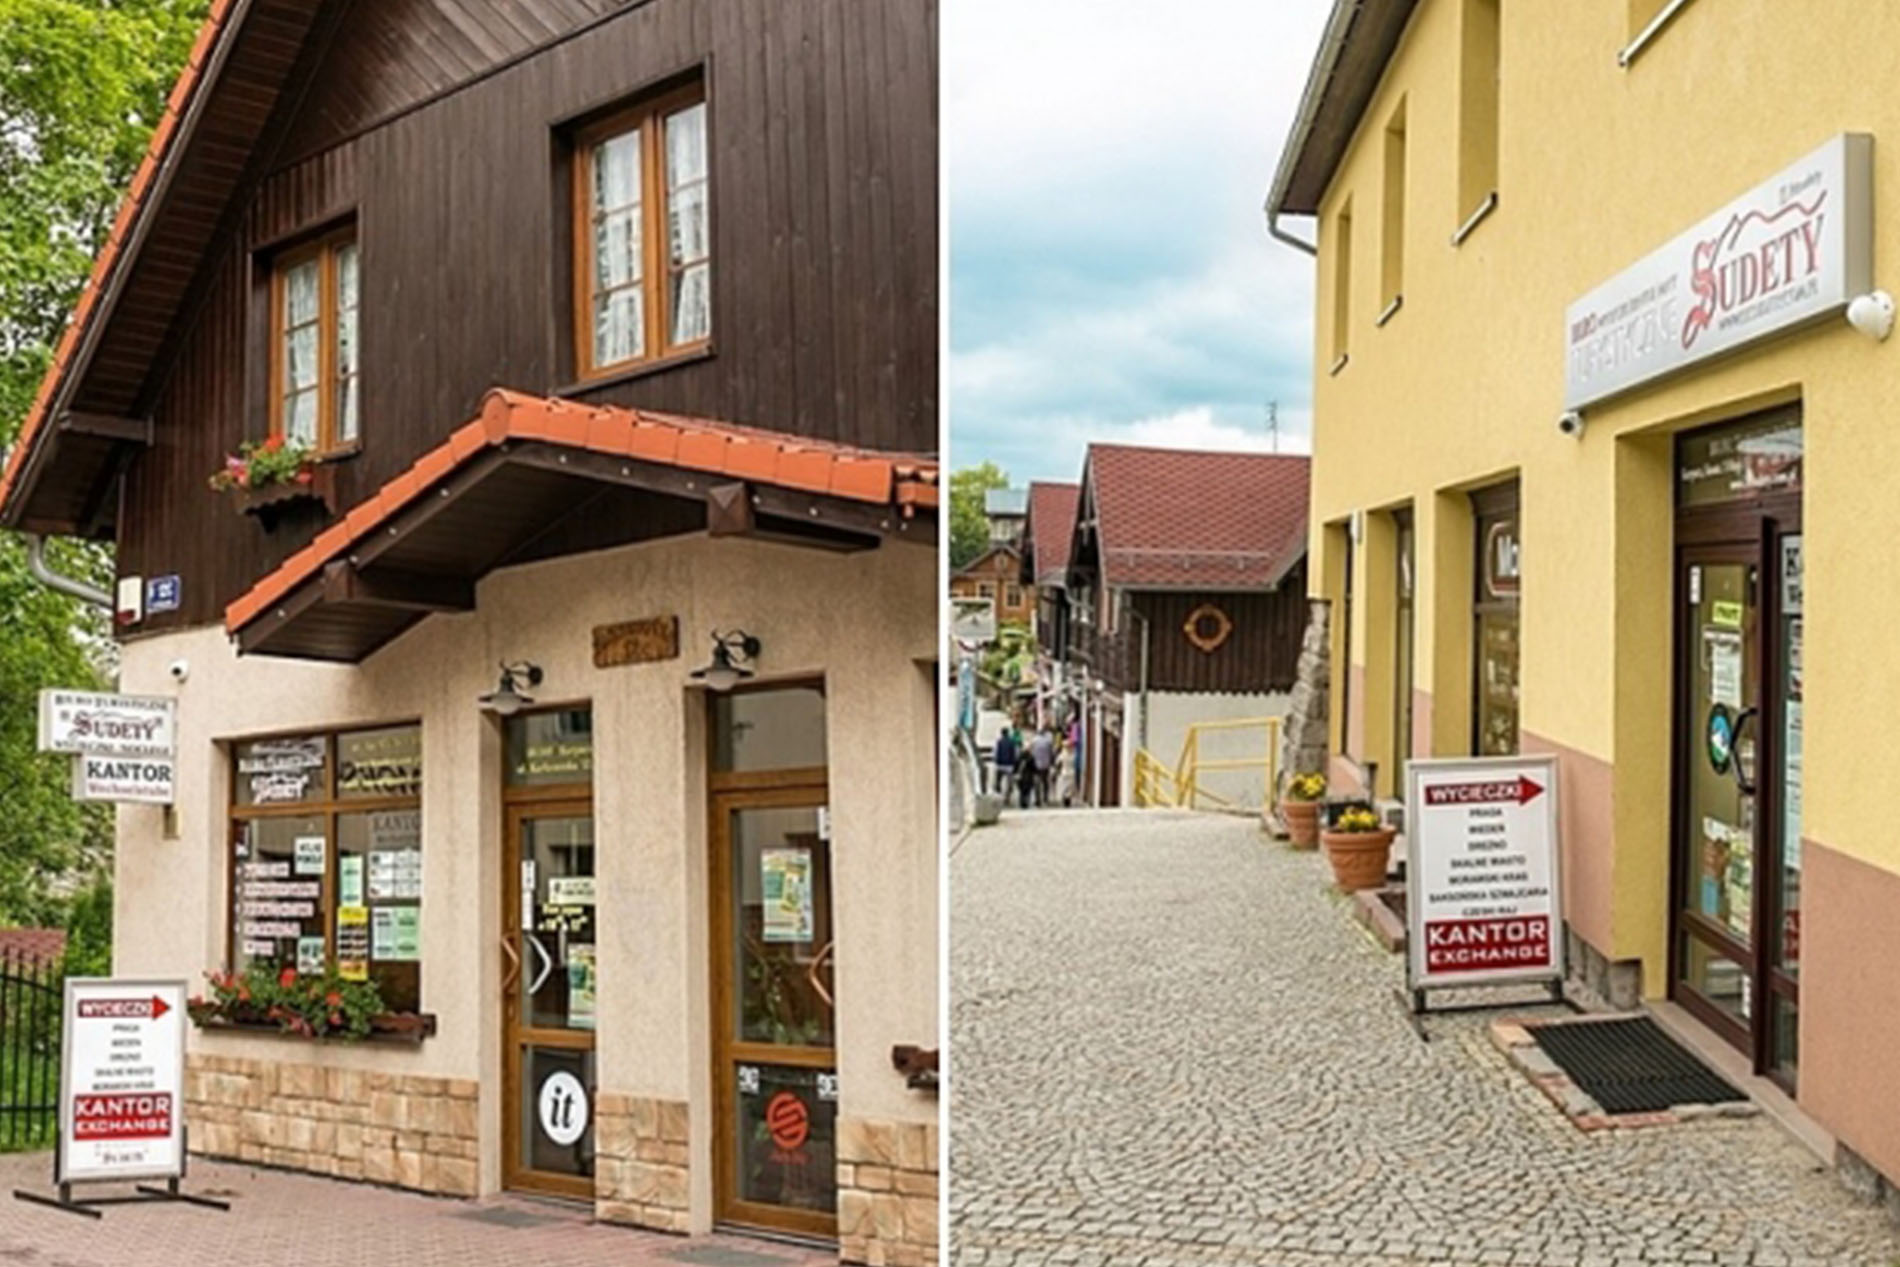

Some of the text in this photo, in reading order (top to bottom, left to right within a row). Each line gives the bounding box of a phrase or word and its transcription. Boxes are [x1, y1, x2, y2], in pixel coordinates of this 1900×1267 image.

[1681, 213, 1824, 350] SUDETY
[87, 761, 172, 781] KANTOR
[1428, 920, 1546, 946] KANTOR
[1429, 943, 1547, 965] EXCHANGE
[76, 1097, 170, 1116] KANTOR
[75, 1117, 170, 1134] EXCHANGE
